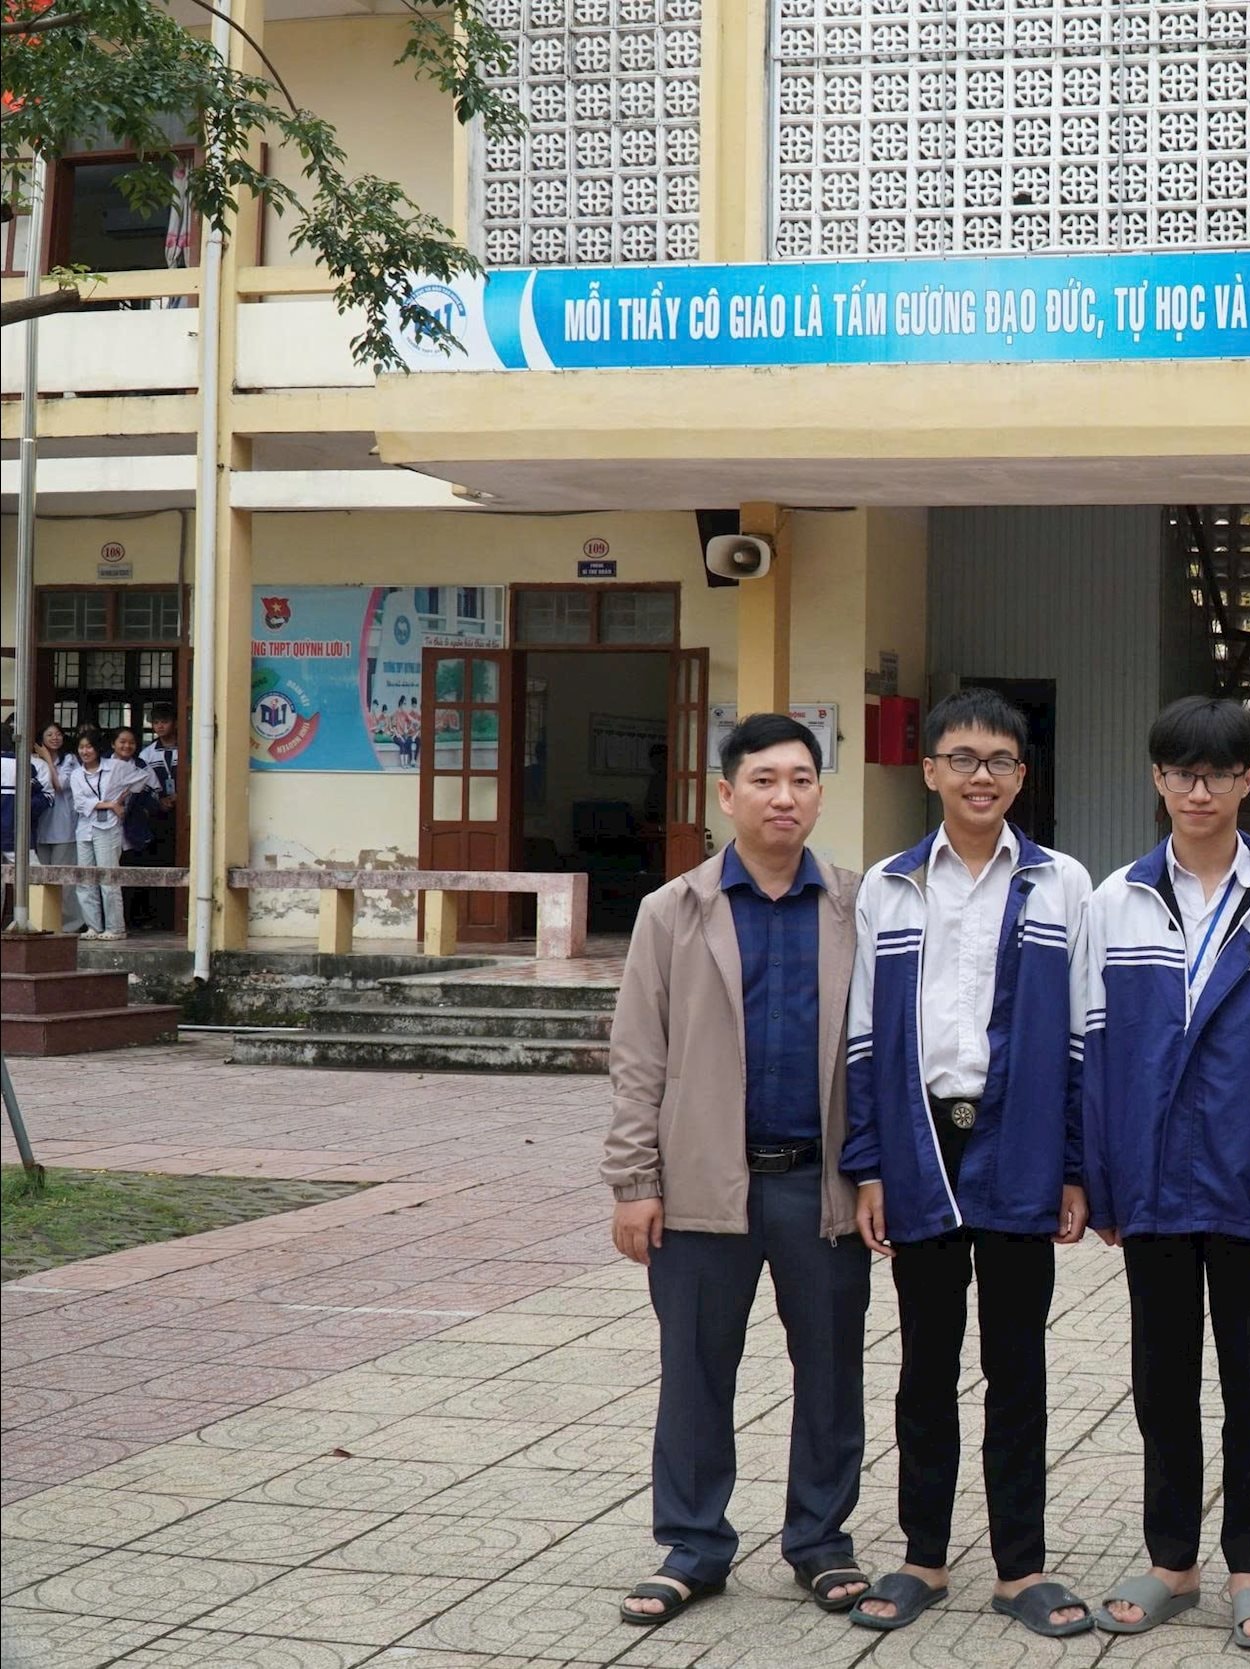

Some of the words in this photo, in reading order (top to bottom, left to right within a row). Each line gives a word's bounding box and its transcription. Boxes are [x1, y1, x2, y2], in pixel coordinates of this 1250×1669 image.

[564, 281, 610, 341] MỖI
[618, 281, 681, 340] THẦY
[689, 287, 721, 340] CÔ
[729, 284, 786, 339] GIÁO
[794, 284, 823, 338] LÀ
[833, 279, 888, 337] TẤM
[895, 284, 978, 336] GƯƠNG
[984, 288, 1036, 345] ĐẠO
[1045, 278, 1105, 339] ĐỨC,
[1114, 280, 1149, 343] TỰ
[1156, 285, 1206, 341] HỌC
[1214, 273, 1248, 329] VÀ
[106, 547, 121, 558] 108
[269, 641, 290, 656] THPT
[293, 639, 323, 657] QUỲNH
[326, 640, 343, 656] LƯU
[346, 642, 350, 656] 1
